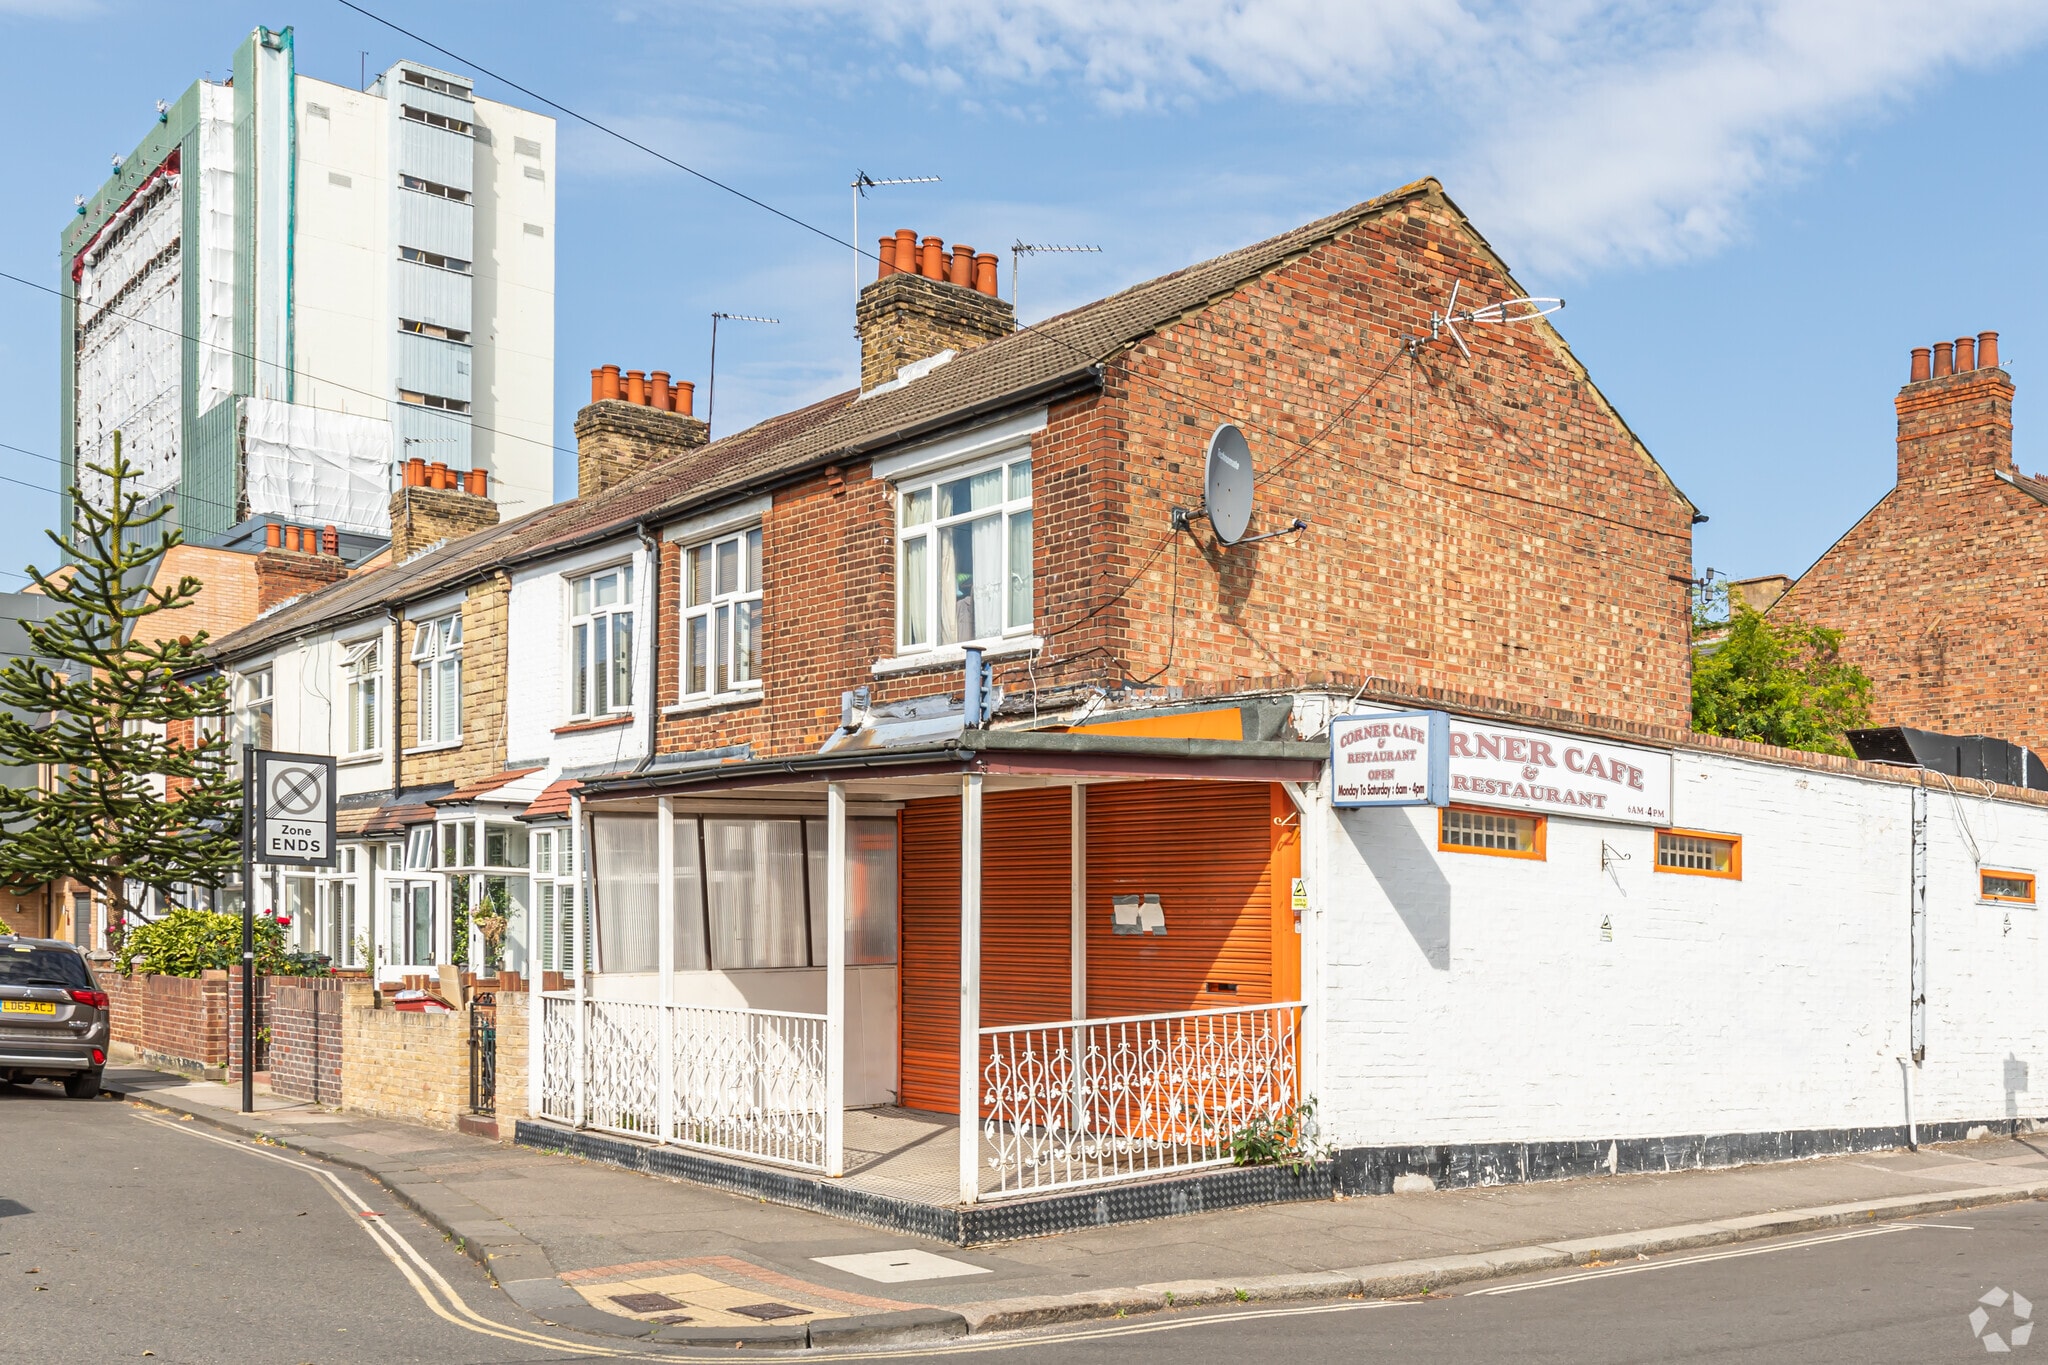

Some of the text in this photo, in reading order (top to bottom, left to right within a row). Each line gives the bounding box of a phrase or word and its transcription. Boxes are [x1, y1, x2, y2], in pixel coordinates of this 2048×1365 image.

[1340, 723, 1425, 748] CORNER CAFE
[1377, 739, 1386, 748] &
[1347, 749, 1417, 763] RESTAURANT
[1449, 732, 1644, 792] RNER CAFE
[1368, 769, 1395, 780] OPEN
[1521, 765, 1539, 781] &
[1338, 784, 1359, 799] Monday
[1360, 784, 1367, 795] To
[1367, 783, 1391, 798] Saturday
[1395, 783, 1408, 794] 6am
[1412, 782, 1425, 797] 4pm
[1452, 774, 1607, 809] RESTAURANT
[282, 825, 312, 836] Zone
[272, 838, 320, 852] ENDS
[3, 1001, 54, 1013] LD65 ACJ
